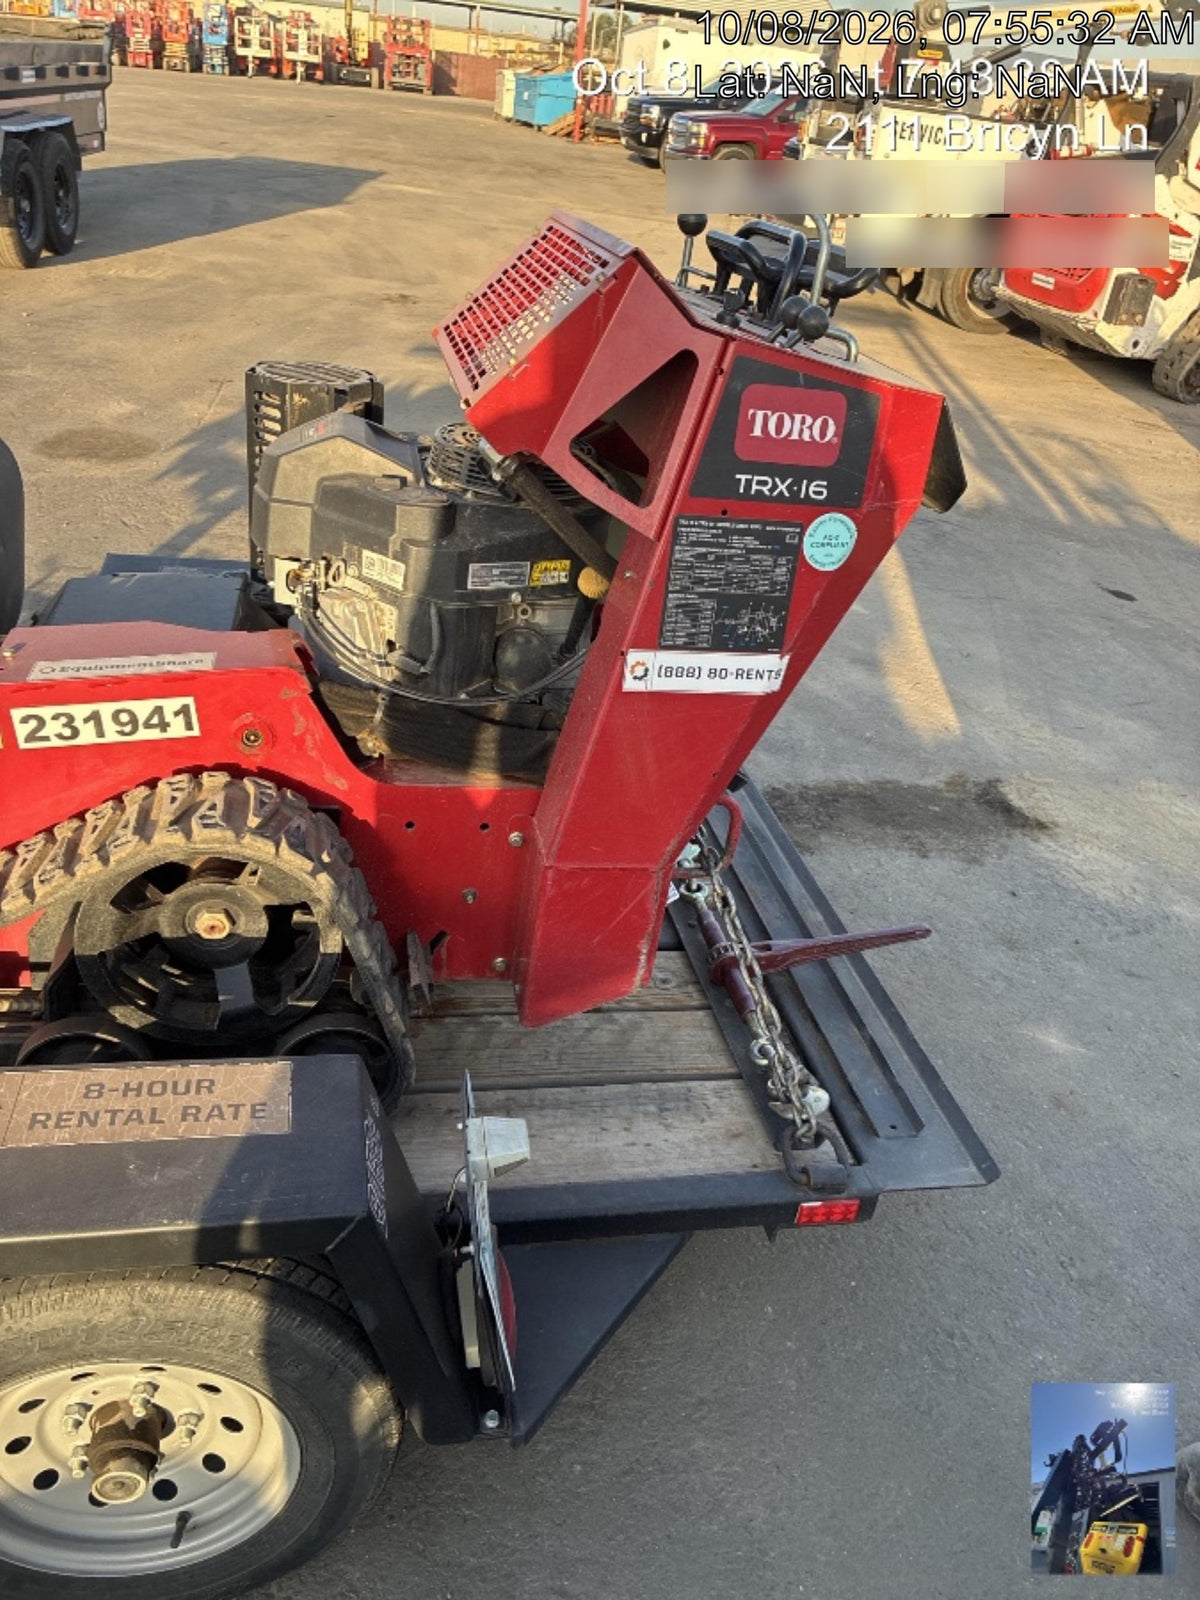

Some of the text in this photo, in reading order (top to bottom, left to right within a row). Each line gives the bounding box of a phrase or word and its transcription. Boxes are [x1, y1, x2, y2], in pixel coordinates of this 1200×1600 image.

[747, 408, 837, 444] TORO
[656, 664, 783, 683] (888) 80-RENTS
[18, 702, 195, 744] 231941
[82, 1077, 216, 1101] 8-HOUR
[27, 1101, 268, 1131] RENTAL RATE
